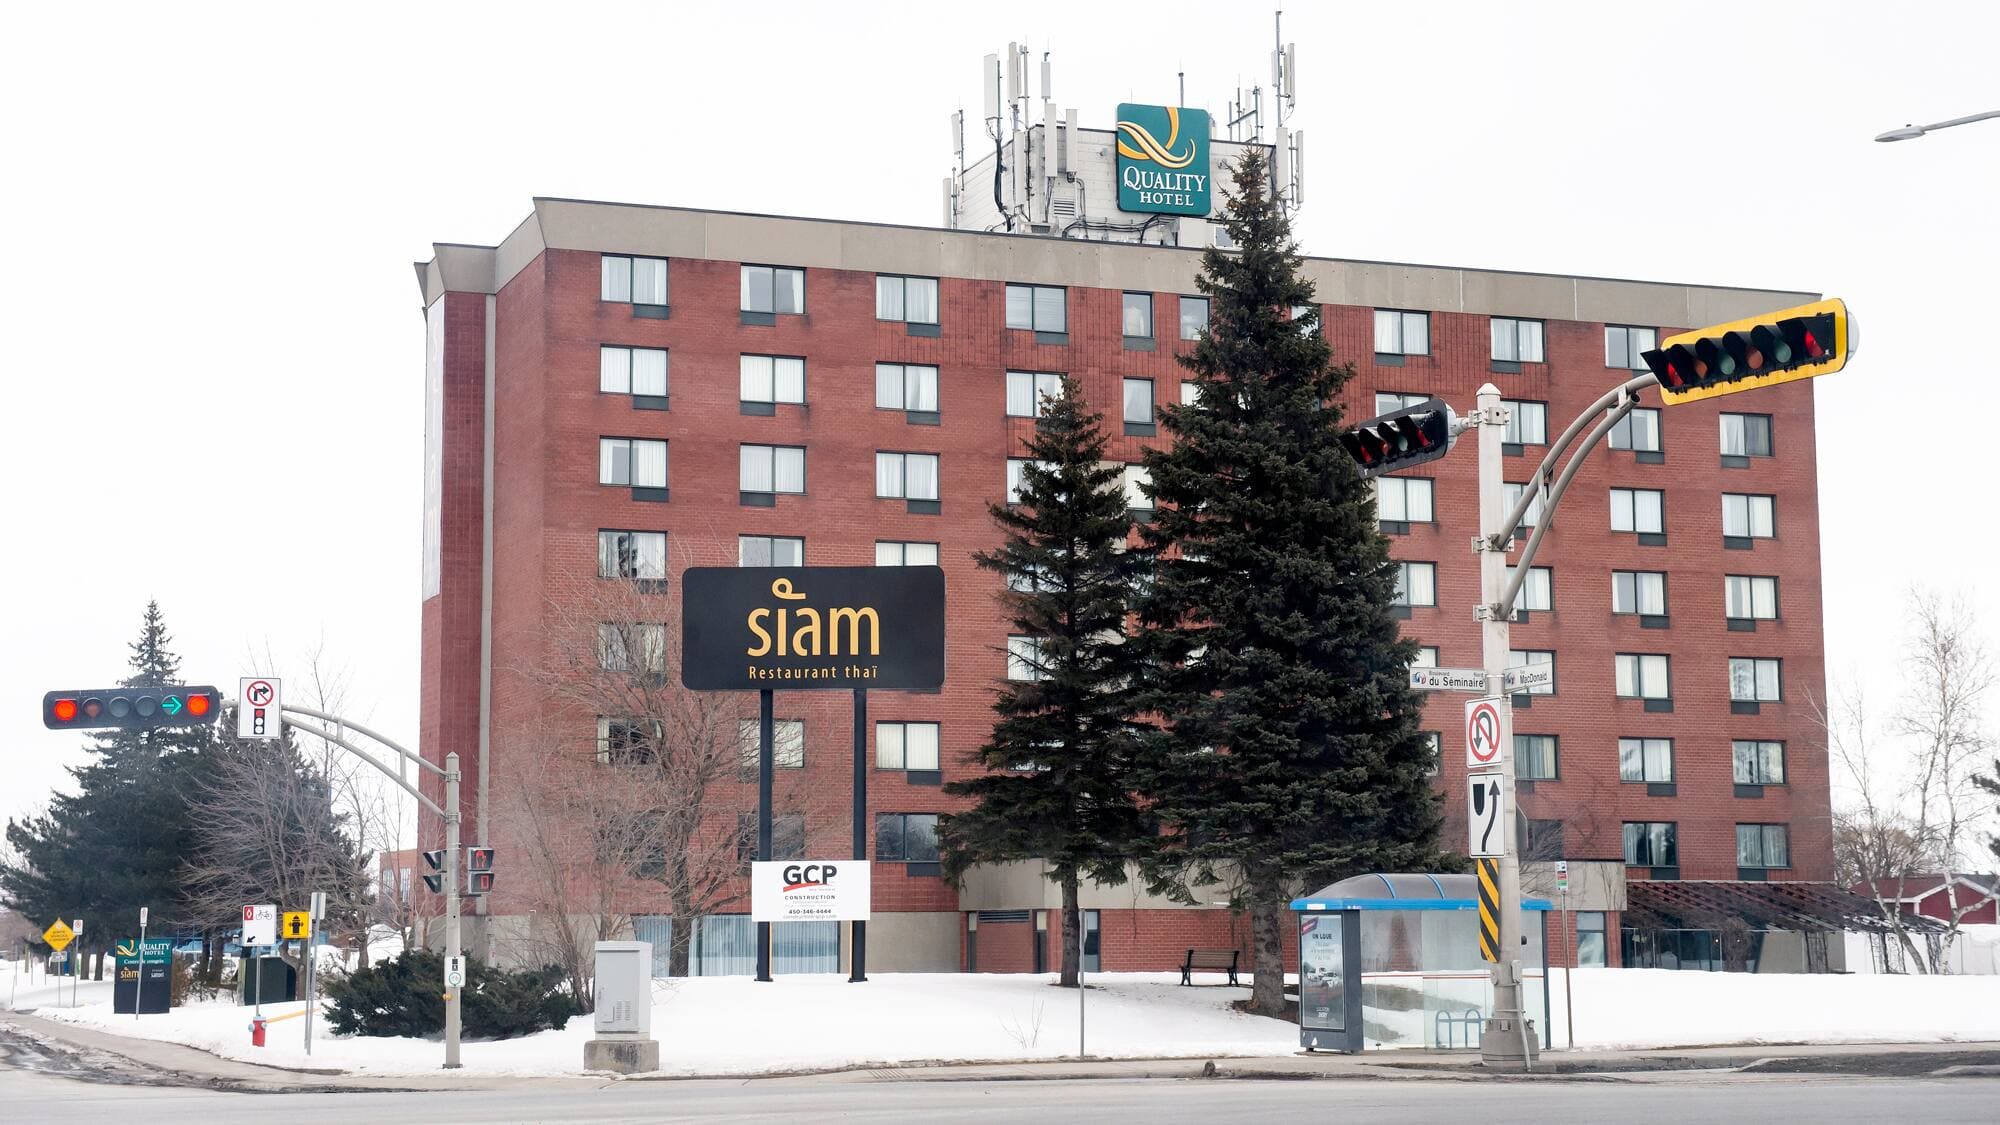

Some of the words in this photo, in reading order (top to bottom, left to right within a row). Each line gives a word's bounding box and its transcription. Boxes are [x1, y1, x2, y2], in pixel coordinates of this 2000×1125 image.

[1123, 166, 1206, 192] QUALITY
[1139, 191, 1194, 206] HOTEL
[747, 578, 880, 656] siam
[749, 665, 837, 680] Restaurant
[845, 665, 878, 679] thaï
[1429, 677, 1440, 686] du
[1443, 676, 1484, 688] Séminaire
[783, 864, 838, 886] GCP
[139, 943, 170, 951] QUALITY
[120, 966, 140, 979] siam
